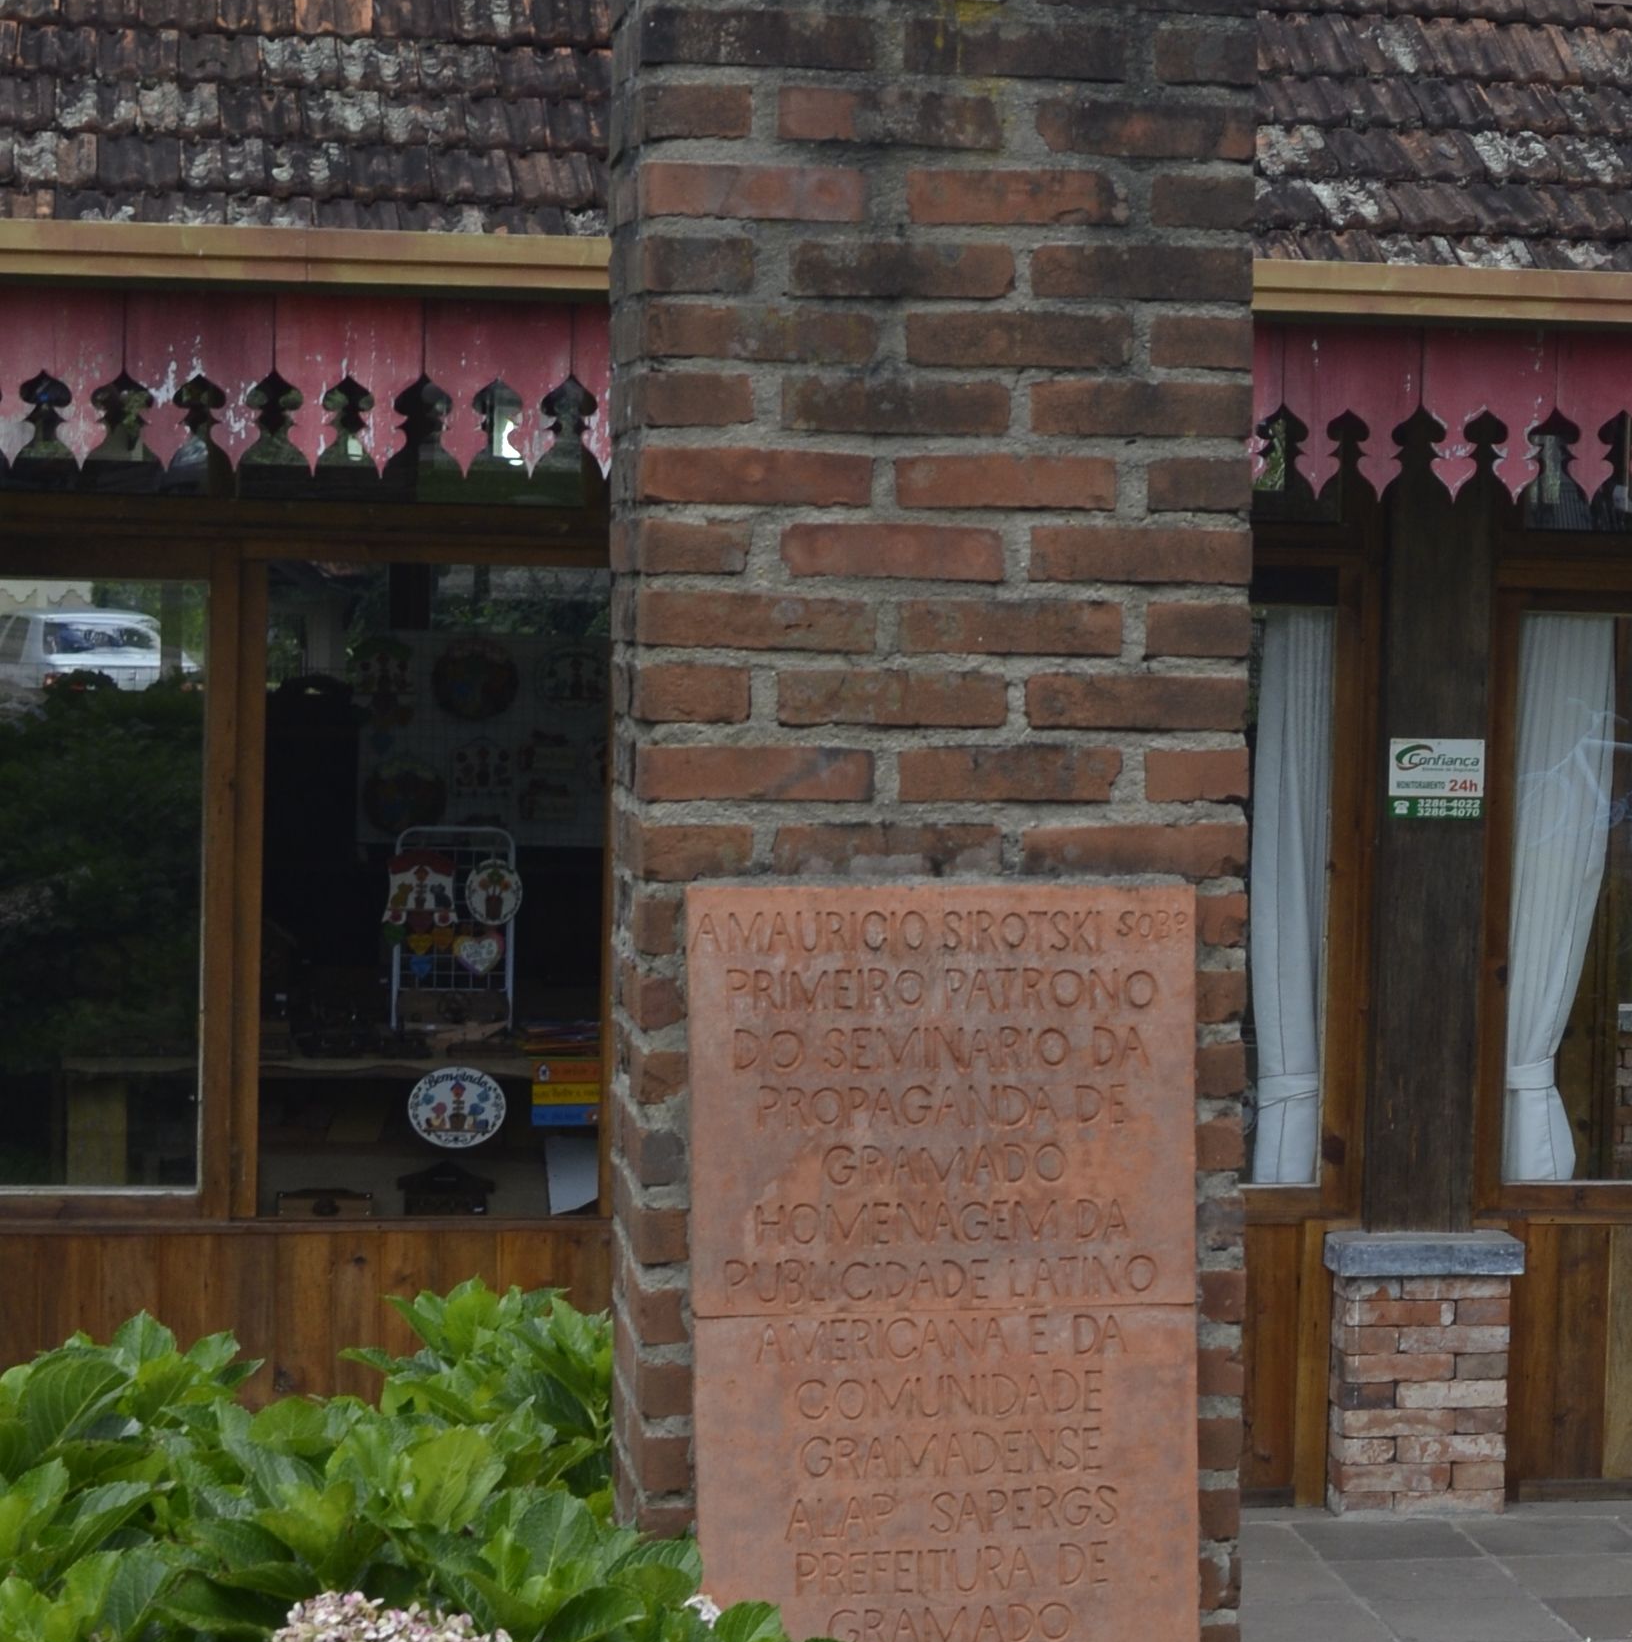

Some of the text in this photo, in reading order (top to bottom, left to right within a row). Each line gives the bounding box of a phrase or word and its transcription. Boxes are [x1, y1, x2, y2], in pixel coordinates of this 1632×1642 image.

[1449, 779, 1478, 792] 24h
[940, 909, 1104, 954] SIROTSKI
[724, 967, 1159, 1012] PRIMEIRO PATRONO
[733, 1025, 1151, 1072] DO SEMINARIO DA
[757, 1083, 1128, 1129] PROPAGANDA DE
[822, 1142, 1068, 1187] GRAMADO
[755, 1198, 1130, 1245] HOMENAGEM DA
[722, 1254, 1159, 1306] PUBLICIDADE LATINO
[756, 1313, 1129, 1364] AMERICANA E DA
[794, 1368, 1103, 1420] COMUNIDADE
[801, 1426, 1103, 1478] GRAMADENSE
[785, 1485, 1120, 1541] ALAP SAPERGS
[796, 1541, 1109, 1596] PREFEITURA DE
